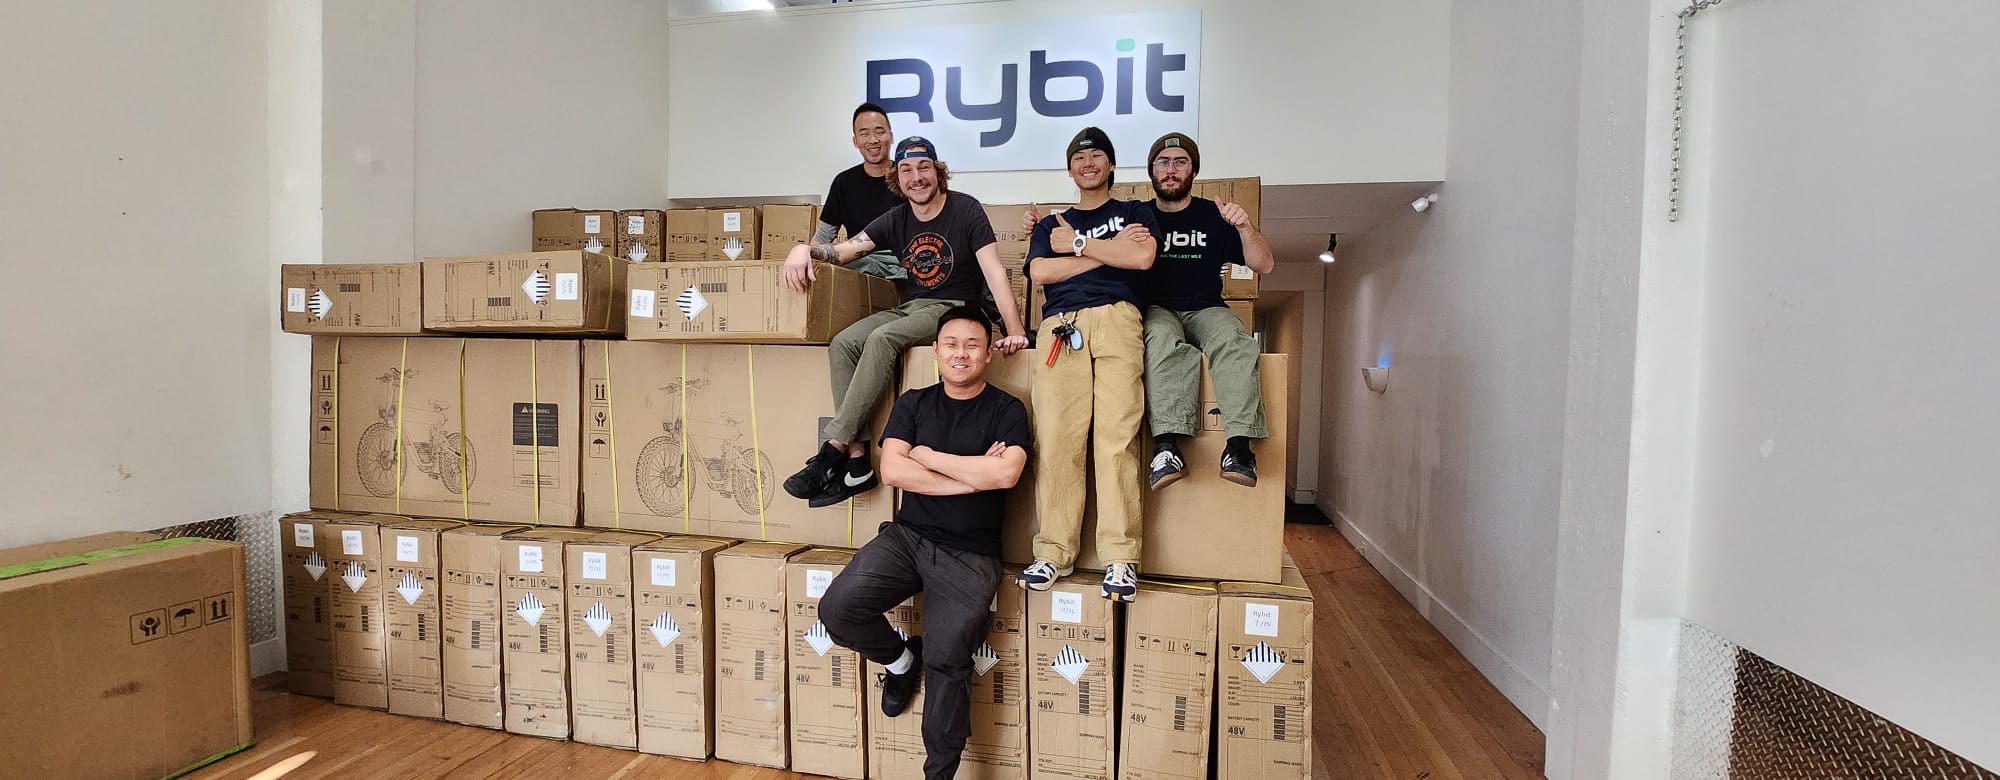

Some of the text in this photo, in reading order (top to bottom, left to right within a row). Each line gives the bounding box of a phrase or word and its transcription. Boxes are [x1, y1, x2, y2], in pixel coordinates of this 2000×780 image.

[866, 38, 1186, 148] Rybit
[1163, 229, 1207, 252] ybit
[1058, 598, 1075, 606] Rybit
[1253, 610, 1271, 619] Rybit
[390, 630, 402, 639] 48V
[508, 642, 521, 651] 48V
[575, 652, 588, 660] 48V
[642, 662, 655, 670] 48V
[721, 667, 734, 676] 48V
[796, 674, 810, 683] 48V
[1038, 701, 1054, 710] 48V
[1131, 713, 1147, 724] 48V
[1228, 726, 1244, 736] 48V
